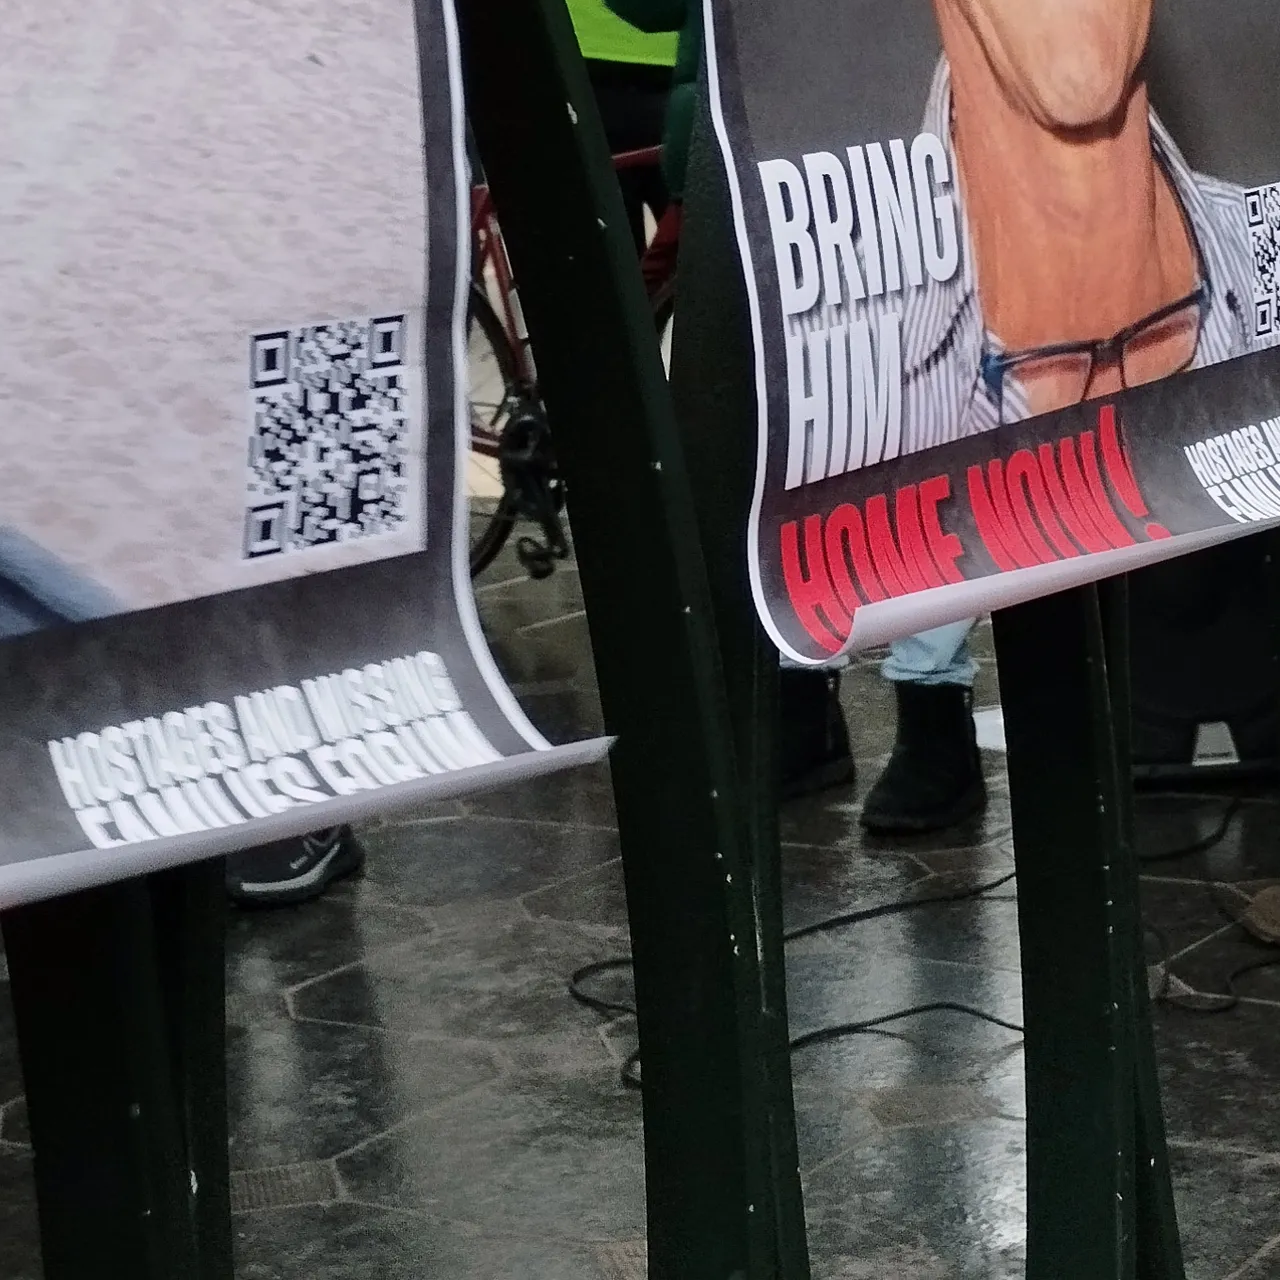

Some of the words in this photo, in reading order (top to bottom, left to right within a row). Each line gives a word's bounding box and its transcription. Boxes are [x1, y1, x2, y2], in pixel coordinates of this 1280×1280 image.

[757, 131, 960, 316] BRING
[784, 314, 908, 491] HIM
[1184, 425, 1277, 488] HOSTAGES
[780, 475, 966, 655] HOME
[968, 404, 1172, 573] NOW!
[48, 701, 251, 809] HOSTAGES
